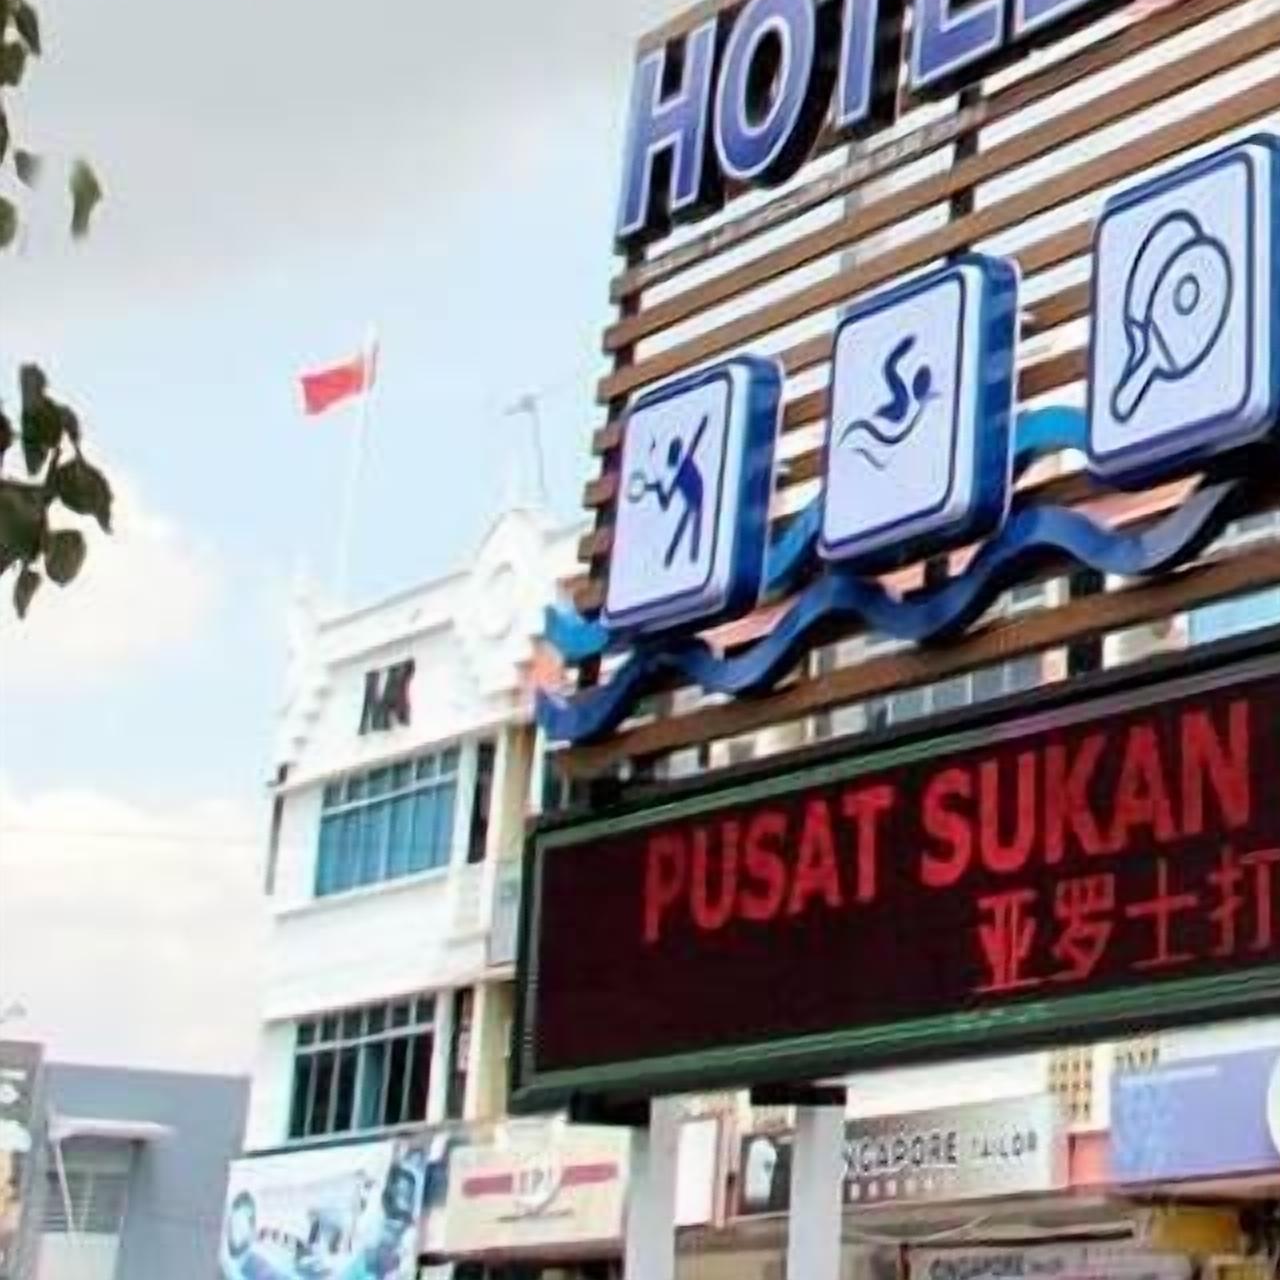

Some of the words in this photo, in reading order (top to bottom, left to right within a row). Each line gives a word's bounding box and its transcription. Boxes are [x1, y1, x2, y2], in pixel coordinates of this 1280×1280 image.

[642, 784, 893, 946] PUSAT
[920, 700, 1250, 888] SUKAN
[842, 1131, 958, 1172] NGAPORE
